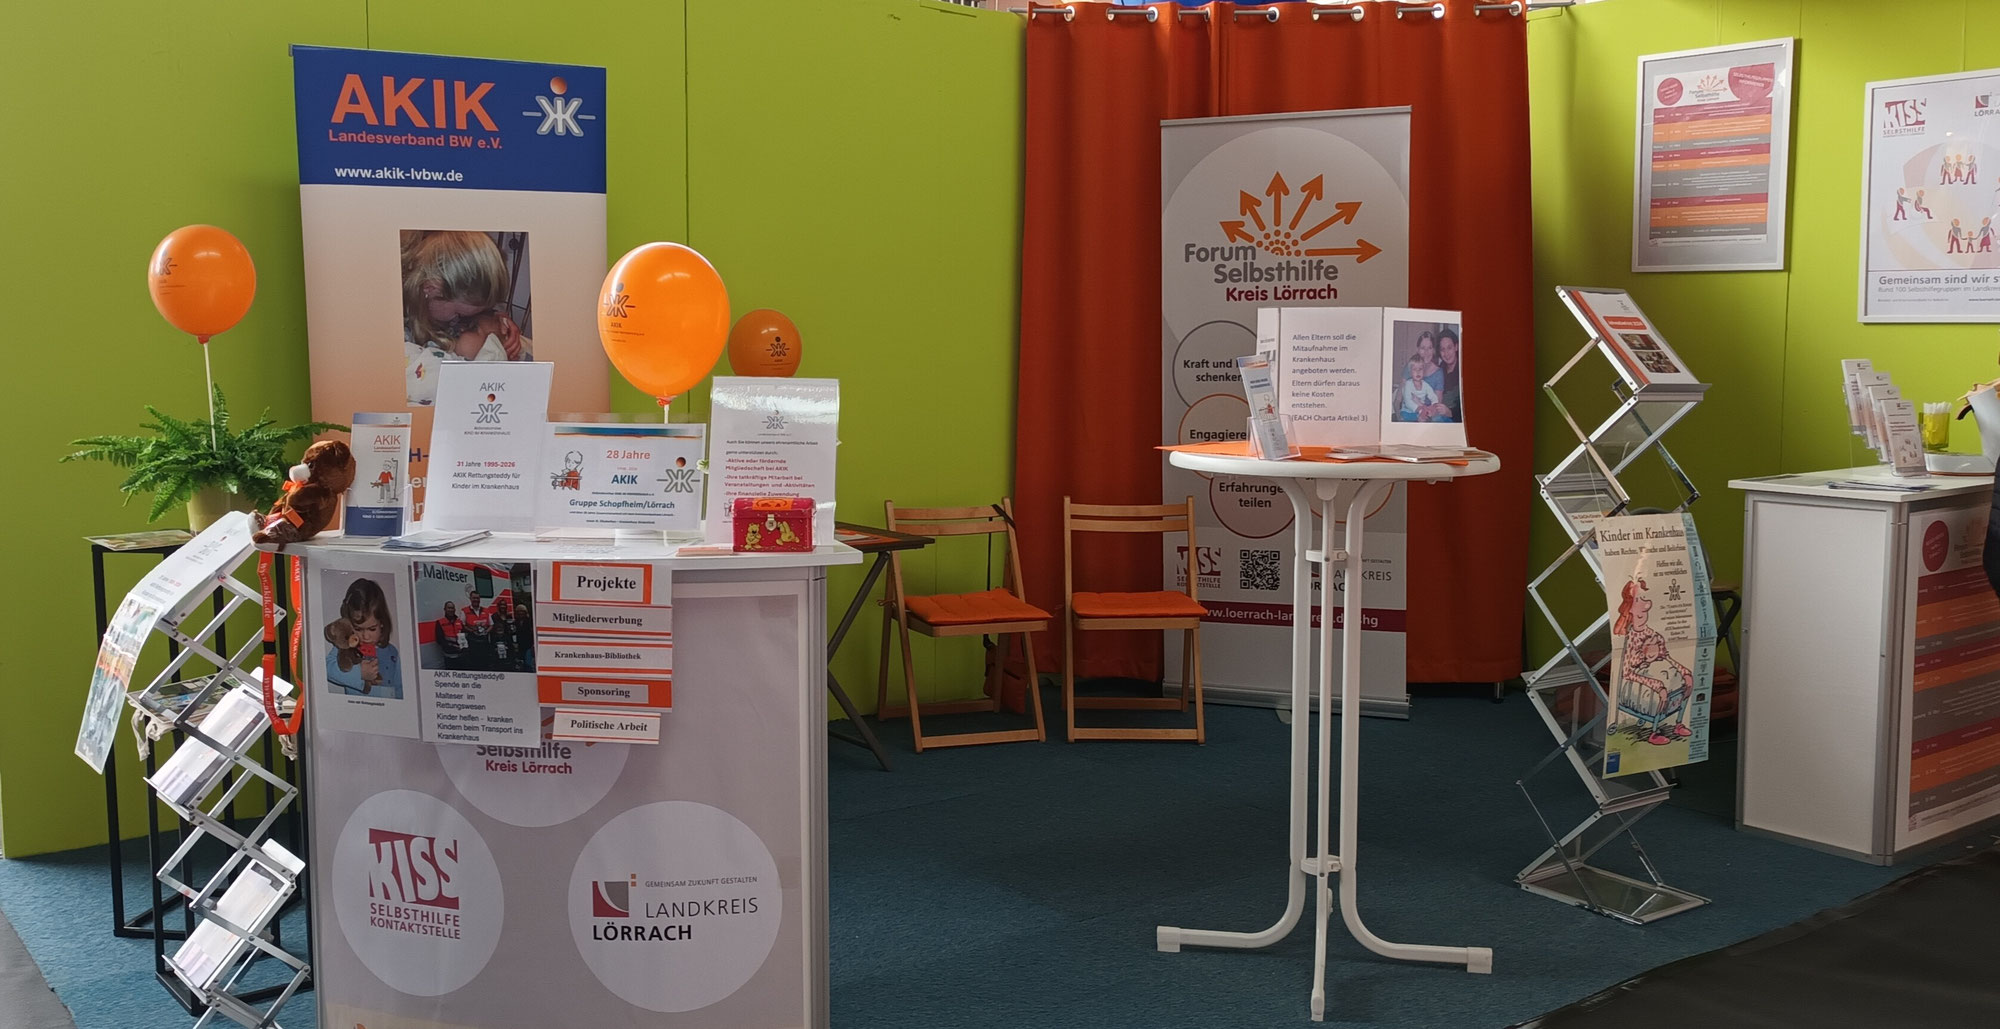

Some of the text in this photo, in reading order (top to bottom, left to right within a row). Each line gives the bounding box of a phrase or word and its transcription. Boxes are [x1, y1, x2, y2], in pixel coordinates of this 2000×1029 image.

[331, 73, 499, 132] AKIK
[1884, 98, 1926, 128] KISS
[1883, 127, 1925, 135] SELBSTHILFE
[328, 129, 502, 149] Landesverband BW e.V.
[334, 166, 464, 182] www.akik-lvbw.de
[1185, 243, 1256, 262] Forum
[1214, 259, 1338, 283] Selbsthilfe
[1879, 276, 1940, 285] Gemeinsam
[1945, 274, 1967, 283] sind
[1971, 274, 1990, 283] wir
[1226, 284, 1338, 301] Kreis Lörrach
[1184, 359, 1210, 368] Kraft
[1213, 359, 1232, 368] und
[480, 382, 506, 392] AKIK
[374, 435, 400, 445] AKIK
[1190, 430, 1247, 441] Engagiere
[607, 450, 650, 459] 28 Jahre
[611, 474, 638, 484] AKIK
[1219, 481, 1284, 495] Erfahrunge
[569, 499, 675, 509] Gruppe Schopfheim/Lörrach
[1239, 497, 1272, 508] teilen
[1600, 526, 1684, 542] Kinder im Krankenhaus
[423, 564, 468, 583] Malteser
[577, 576, 636, 591] Projekte
[552, 613, 643, 626] Mitgliederwerbung
[555, 651, 641, 660] Krankenhaus-Bibliothek
[435, 680, 460, 688] Spende
[577, 686, 630, 698] Sponsoring
[436, 702, 486, 710] Rettungswesen
[481, 725, 512, 733] Transport
[514, 726, 523, 734] ins
[571, 720, 648, 732] Politische Arbeit
[438, 733, 479, 741] Krankenhaus
[485, 759, 572, 774] Kreis Lörrach
[369, 828, 459, 910] KISS
[688, 878, 718, 887] ZUKUNFT
[646, 897, 758, 918] LANDKREIS
[370, 902, 459, 927] SELBSTHILFE
[370, 916, 460, 939] KONTAKTSTELLE
[593, 922, 692, 941] LÖRRACH
